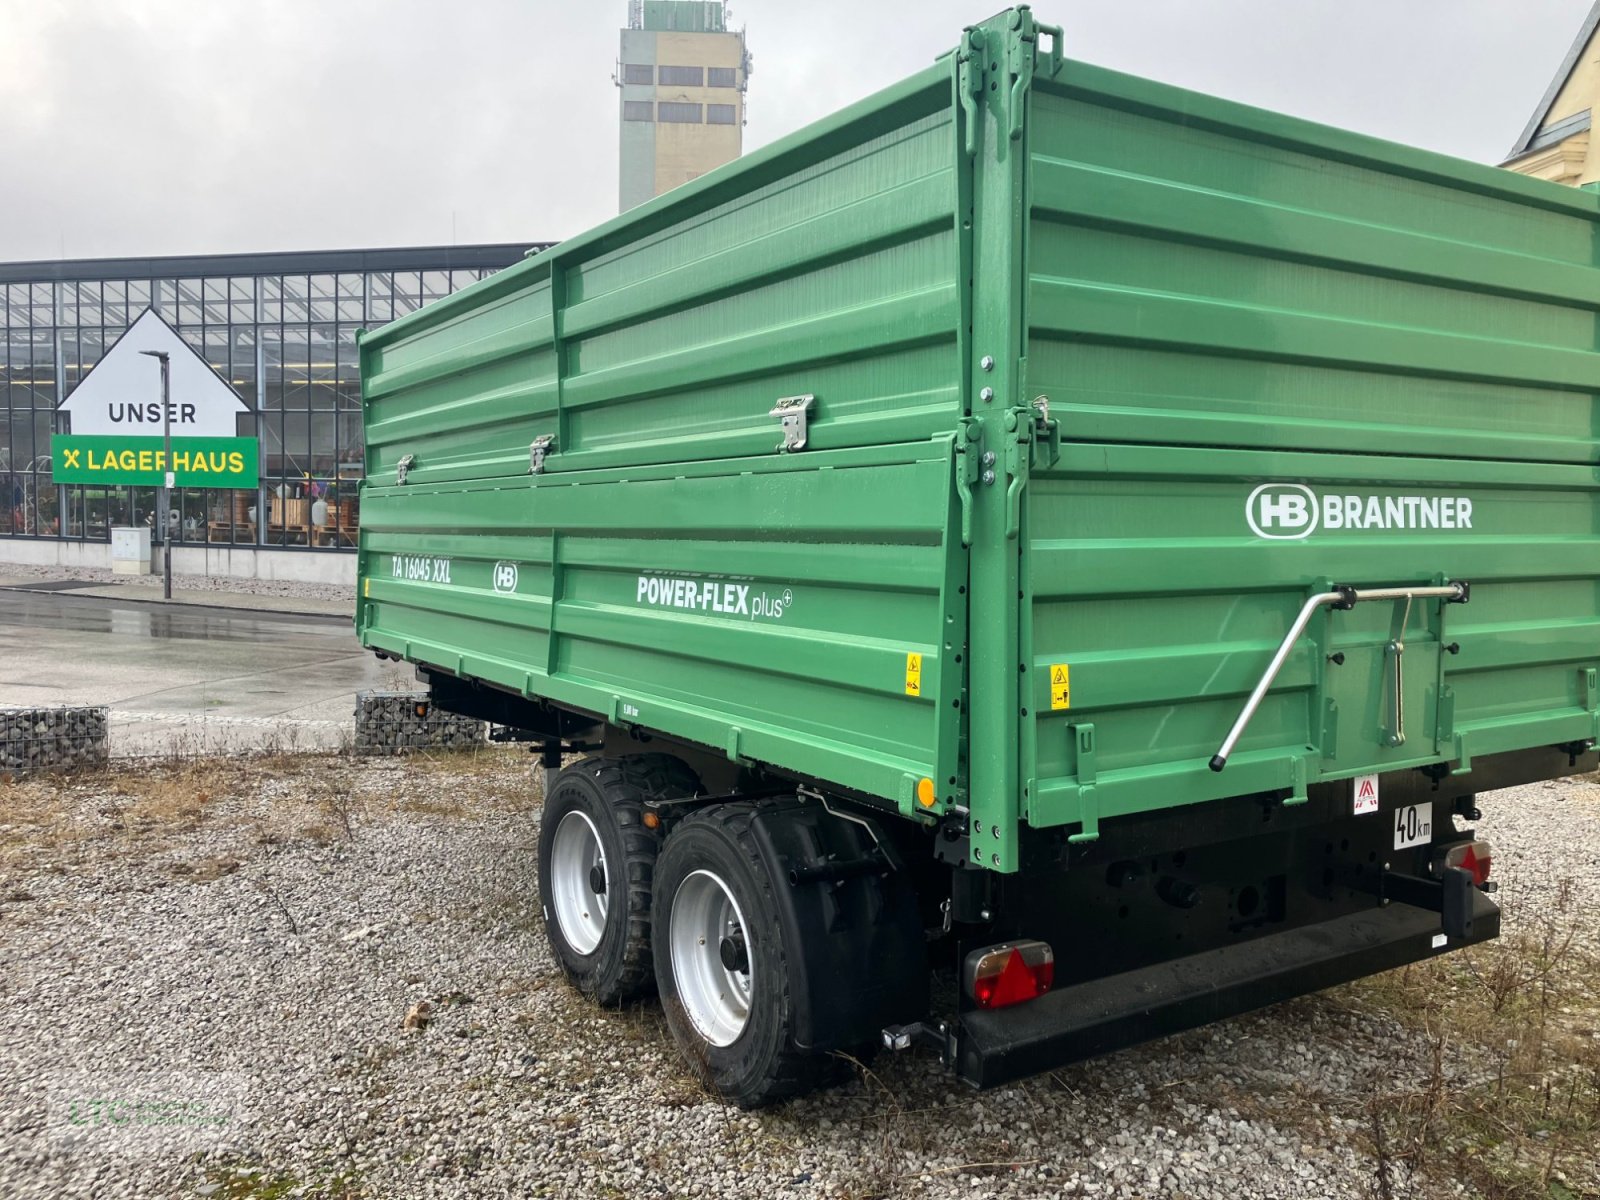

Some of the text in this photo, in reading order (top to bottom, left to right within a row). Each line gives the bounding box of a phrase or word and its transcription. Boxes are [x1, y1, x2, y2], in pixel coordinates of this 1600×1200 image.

[109, 403, 196, 423] UNSER
[1260, 494, 1473, 529] HB BRANTNER
[392, 556, 451, 584] TA 16045 XXL
[636, 576, 749, 615] POWER-FLEX
